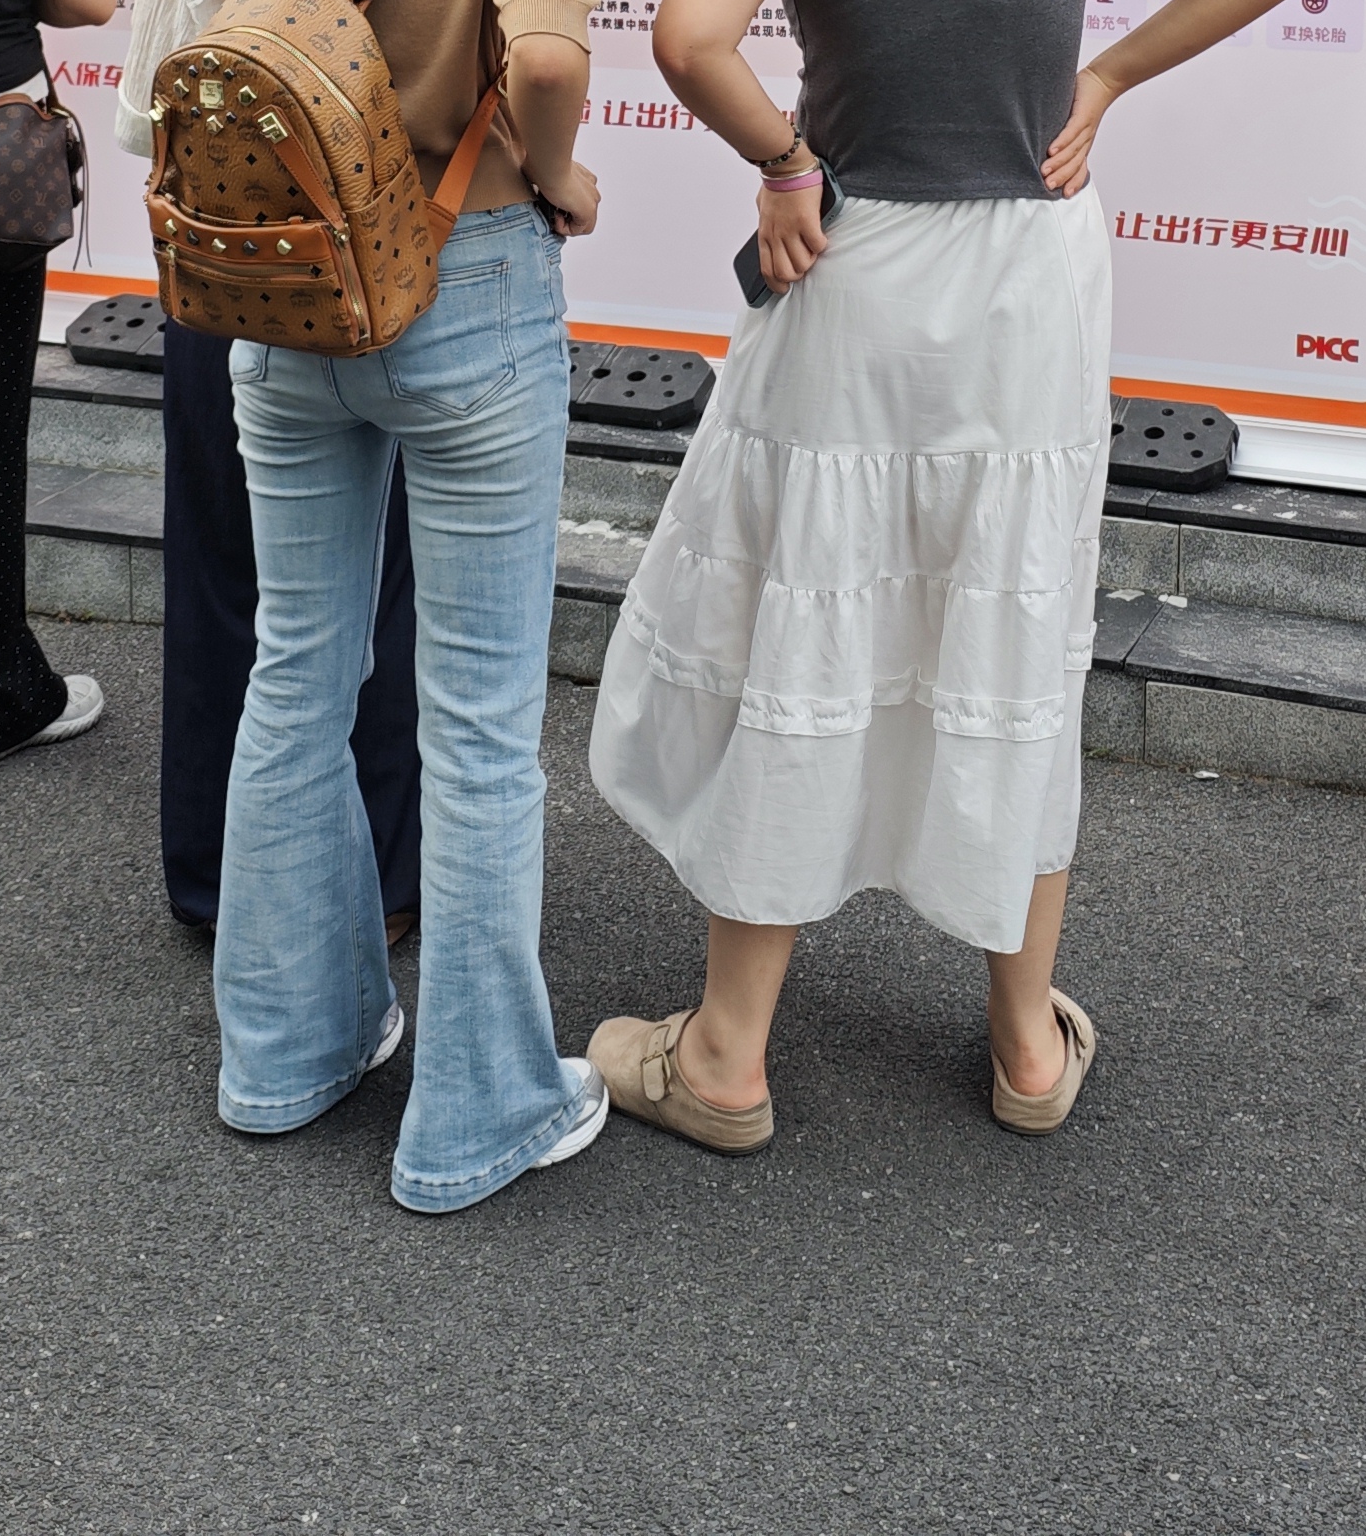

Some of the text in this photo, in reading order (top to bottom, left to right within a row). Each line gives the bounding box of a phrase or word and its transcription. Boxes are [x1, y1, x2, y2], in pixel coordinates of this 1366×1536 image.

[1282, 25, 1347, 43] 更换轮胎
[1115, 211, 1349, 257] 让出行更安心
[1296, 333, 1360, 363] PICC
